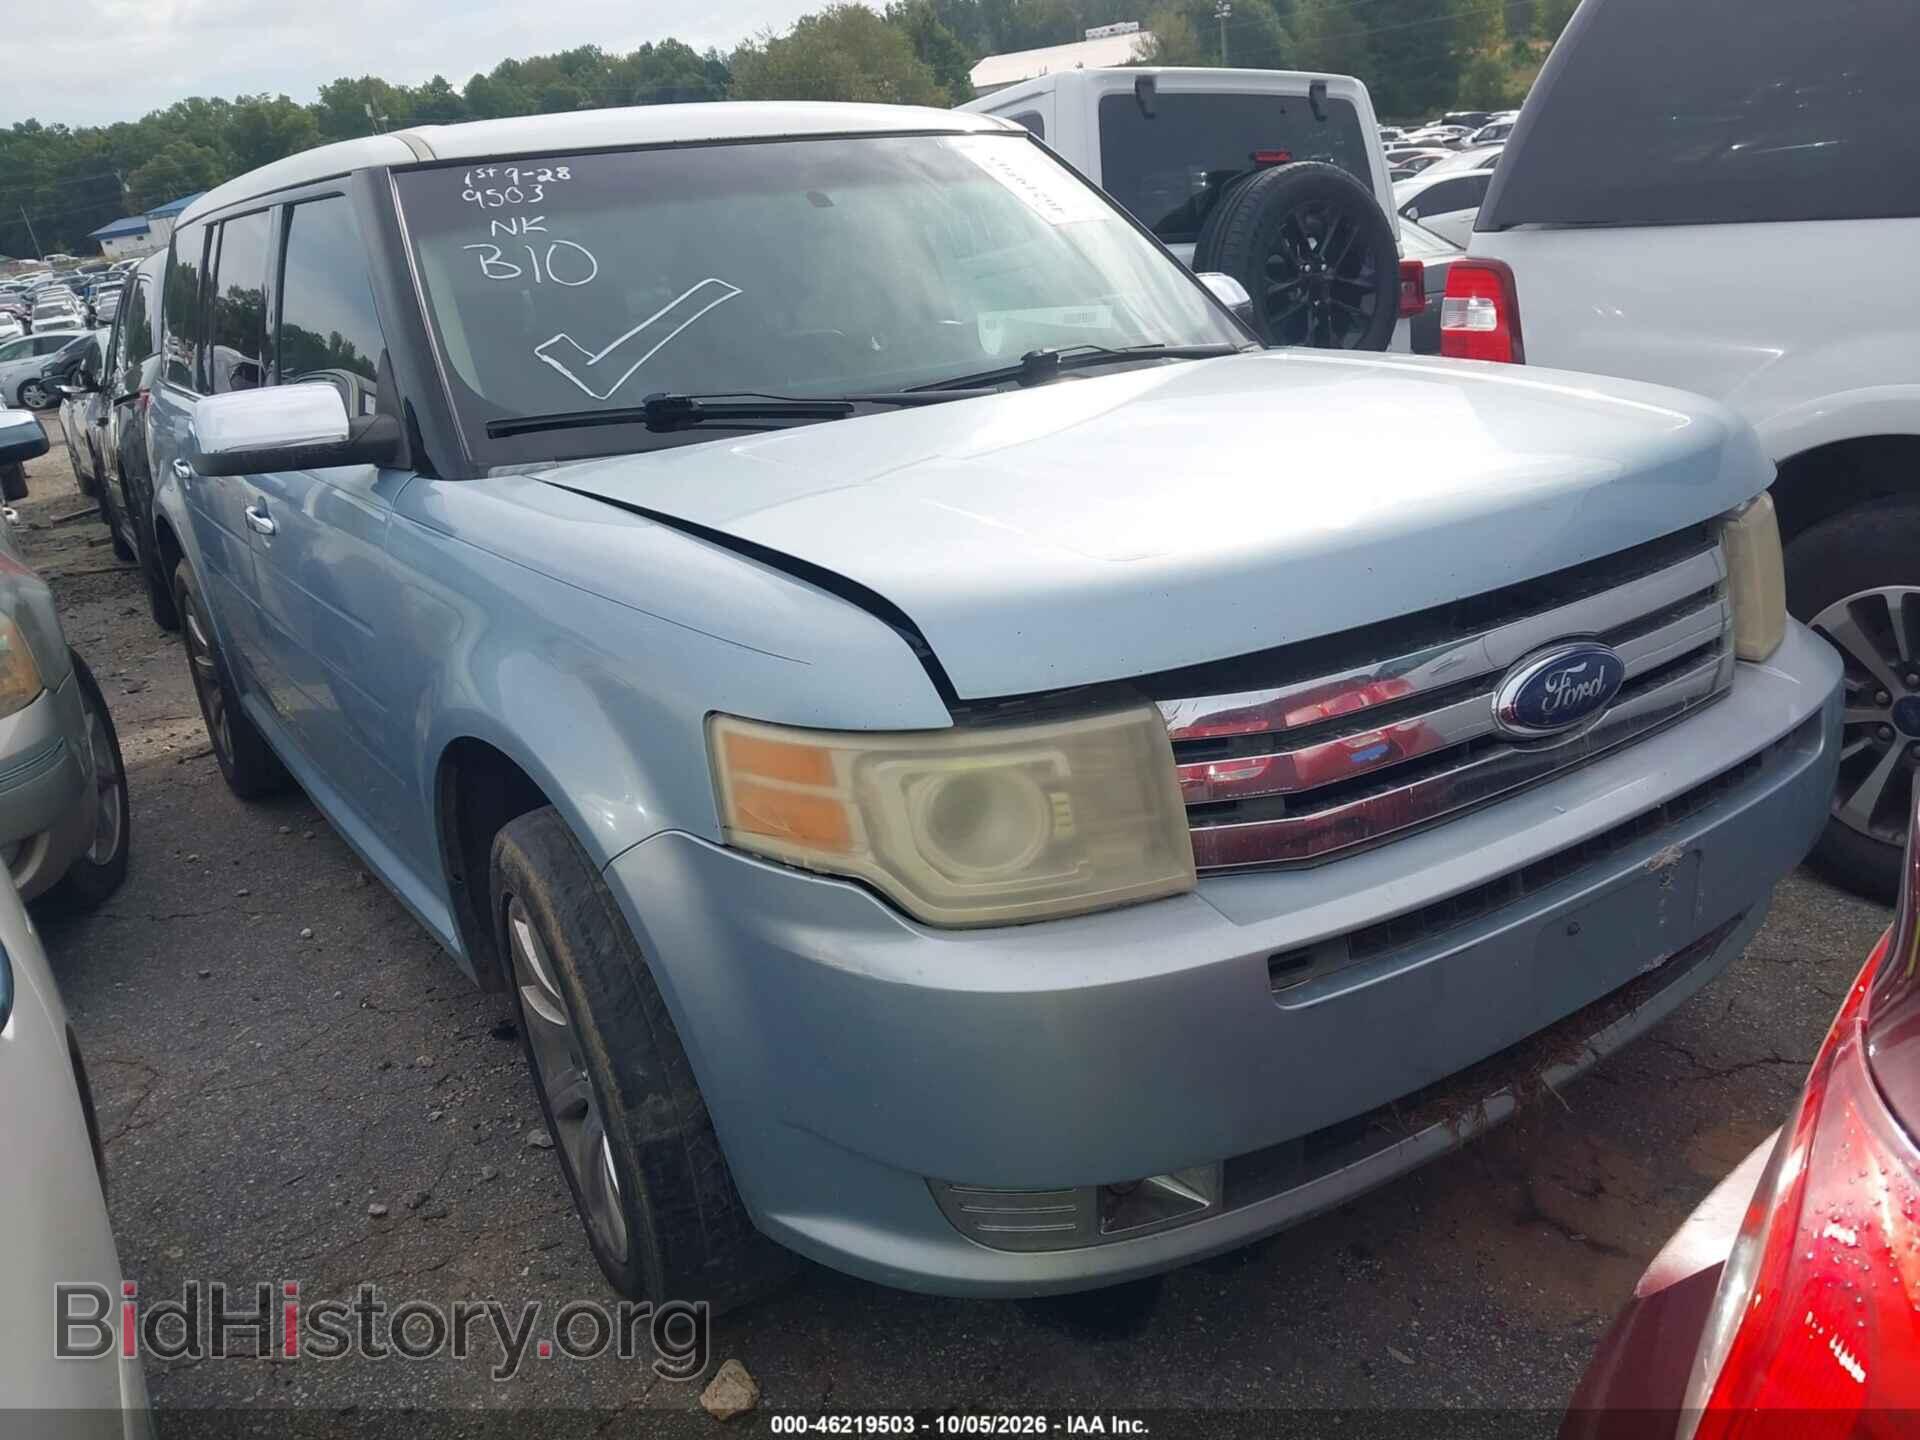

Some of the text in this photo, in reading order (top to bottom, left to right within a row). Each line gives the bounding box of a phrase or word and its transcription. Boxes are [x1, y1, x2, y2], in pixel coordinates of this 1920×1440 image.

[504, 167, 572, 186] 9-28
[462, 184, 544, 208] 9503
[491, 216, 548, 237] NK
[1541, 661, 1607, 711] Ford
